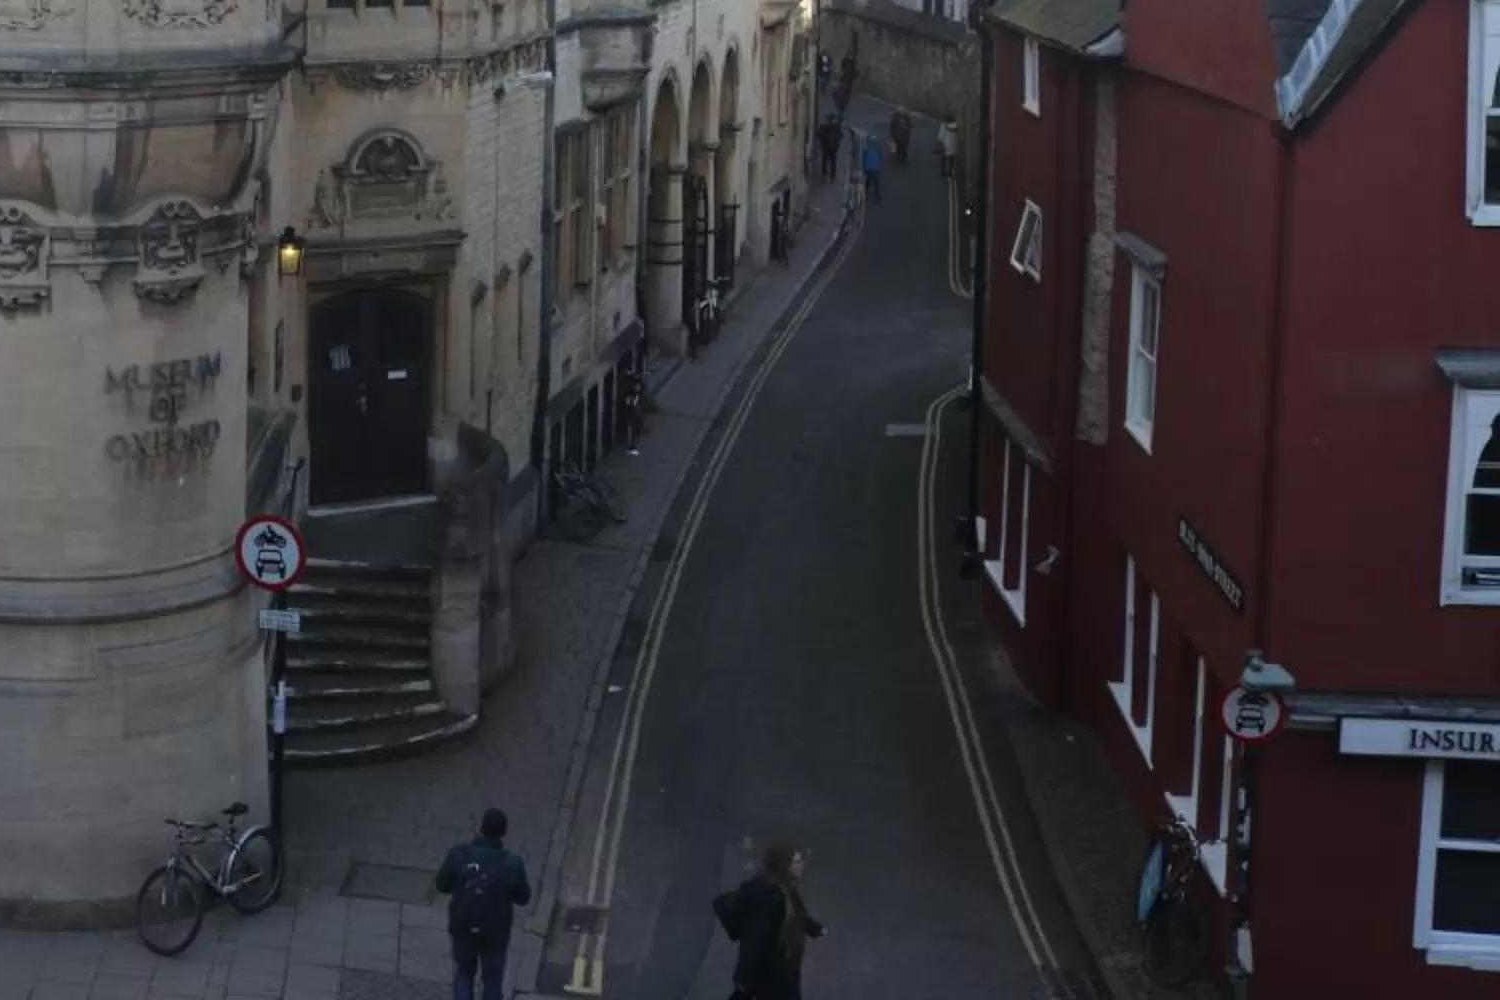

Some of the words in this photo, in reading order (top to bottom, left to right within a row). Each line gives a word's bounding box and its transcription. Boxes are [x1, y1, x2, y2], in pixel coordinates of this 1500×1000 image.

[104, 351, 221, 395] MUSEUM
[104, 420, 221, 461] OXFORD
[1409, 728, 1500, 752] INSUR
